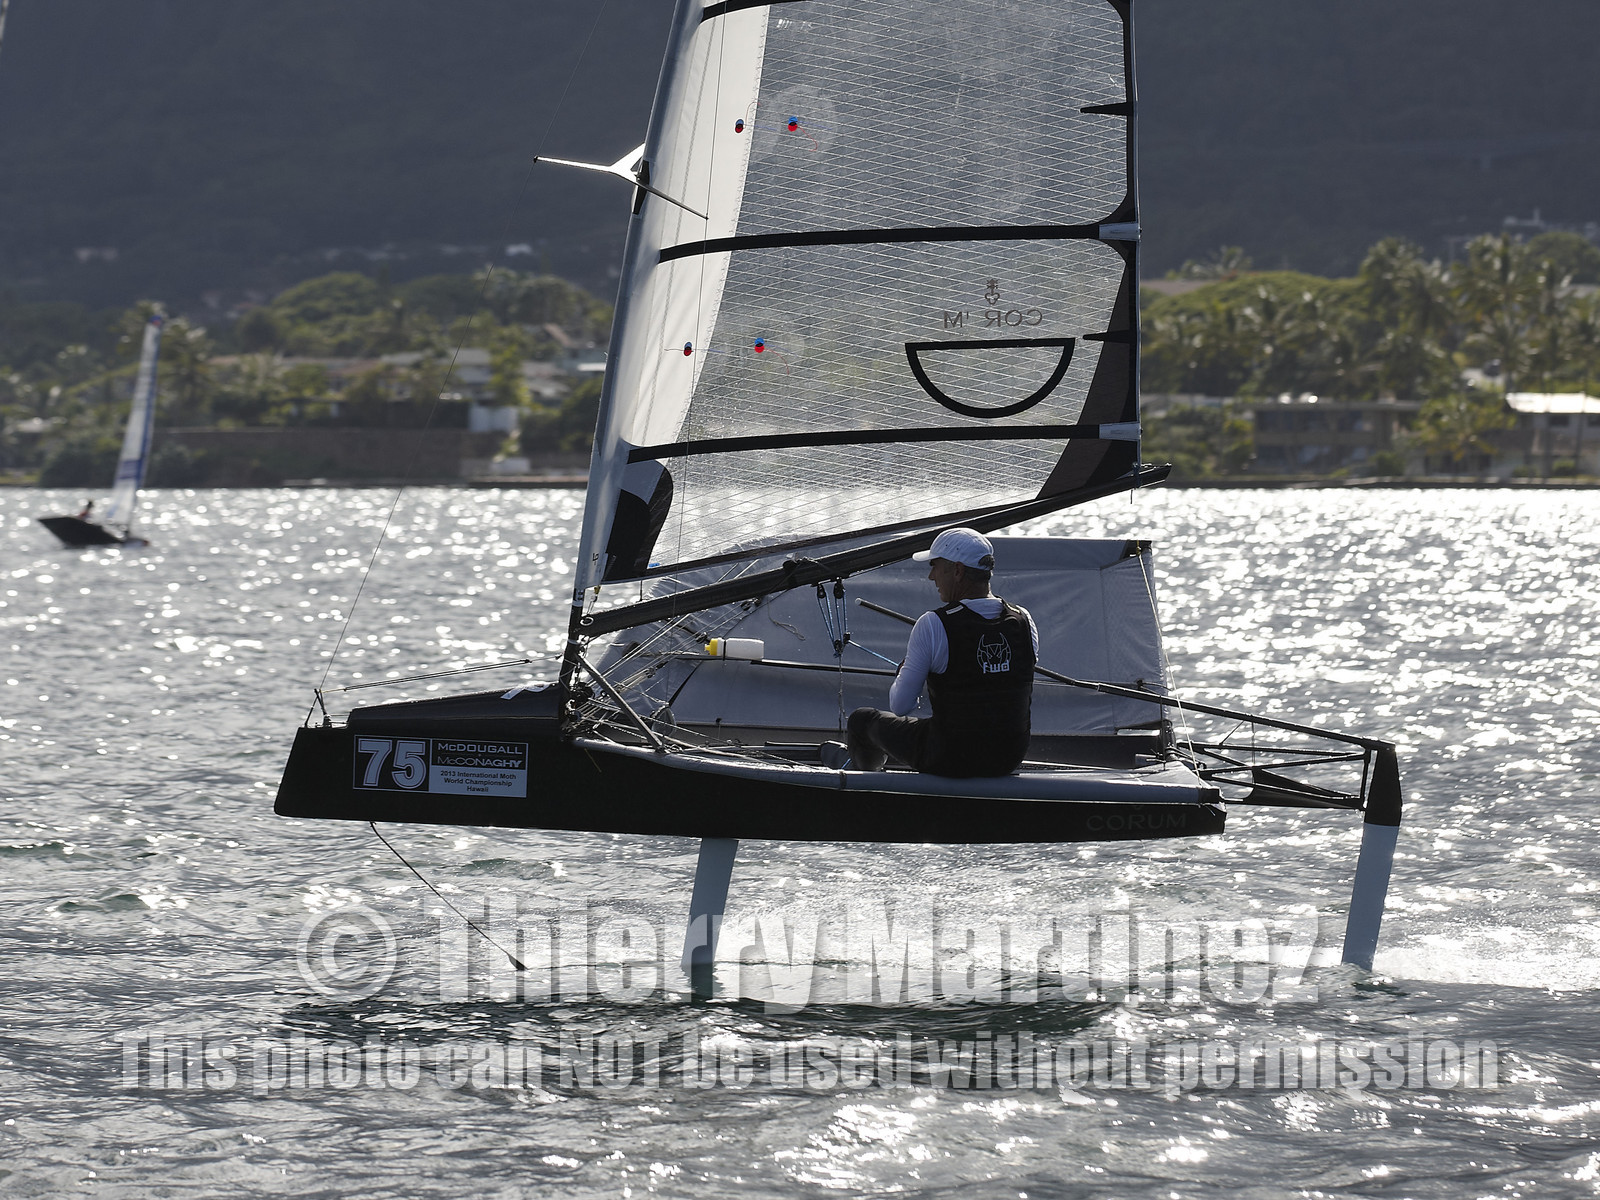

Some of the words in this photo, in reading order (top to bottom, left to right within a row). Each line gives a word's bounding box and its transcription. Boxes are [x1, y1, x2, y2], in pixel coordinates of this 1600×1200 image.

[437, 742, 523, 755] McDOUGALL
[358, 738, 427, 789] 75
[437, 756, 522, 768] McCONAGHY
[457, 771, 499, 779] International
[465, 778, 513, 787] Championship
[467, 785, 489, 793] Hawaii
[1086, 813, 1187, 831] CORUM
